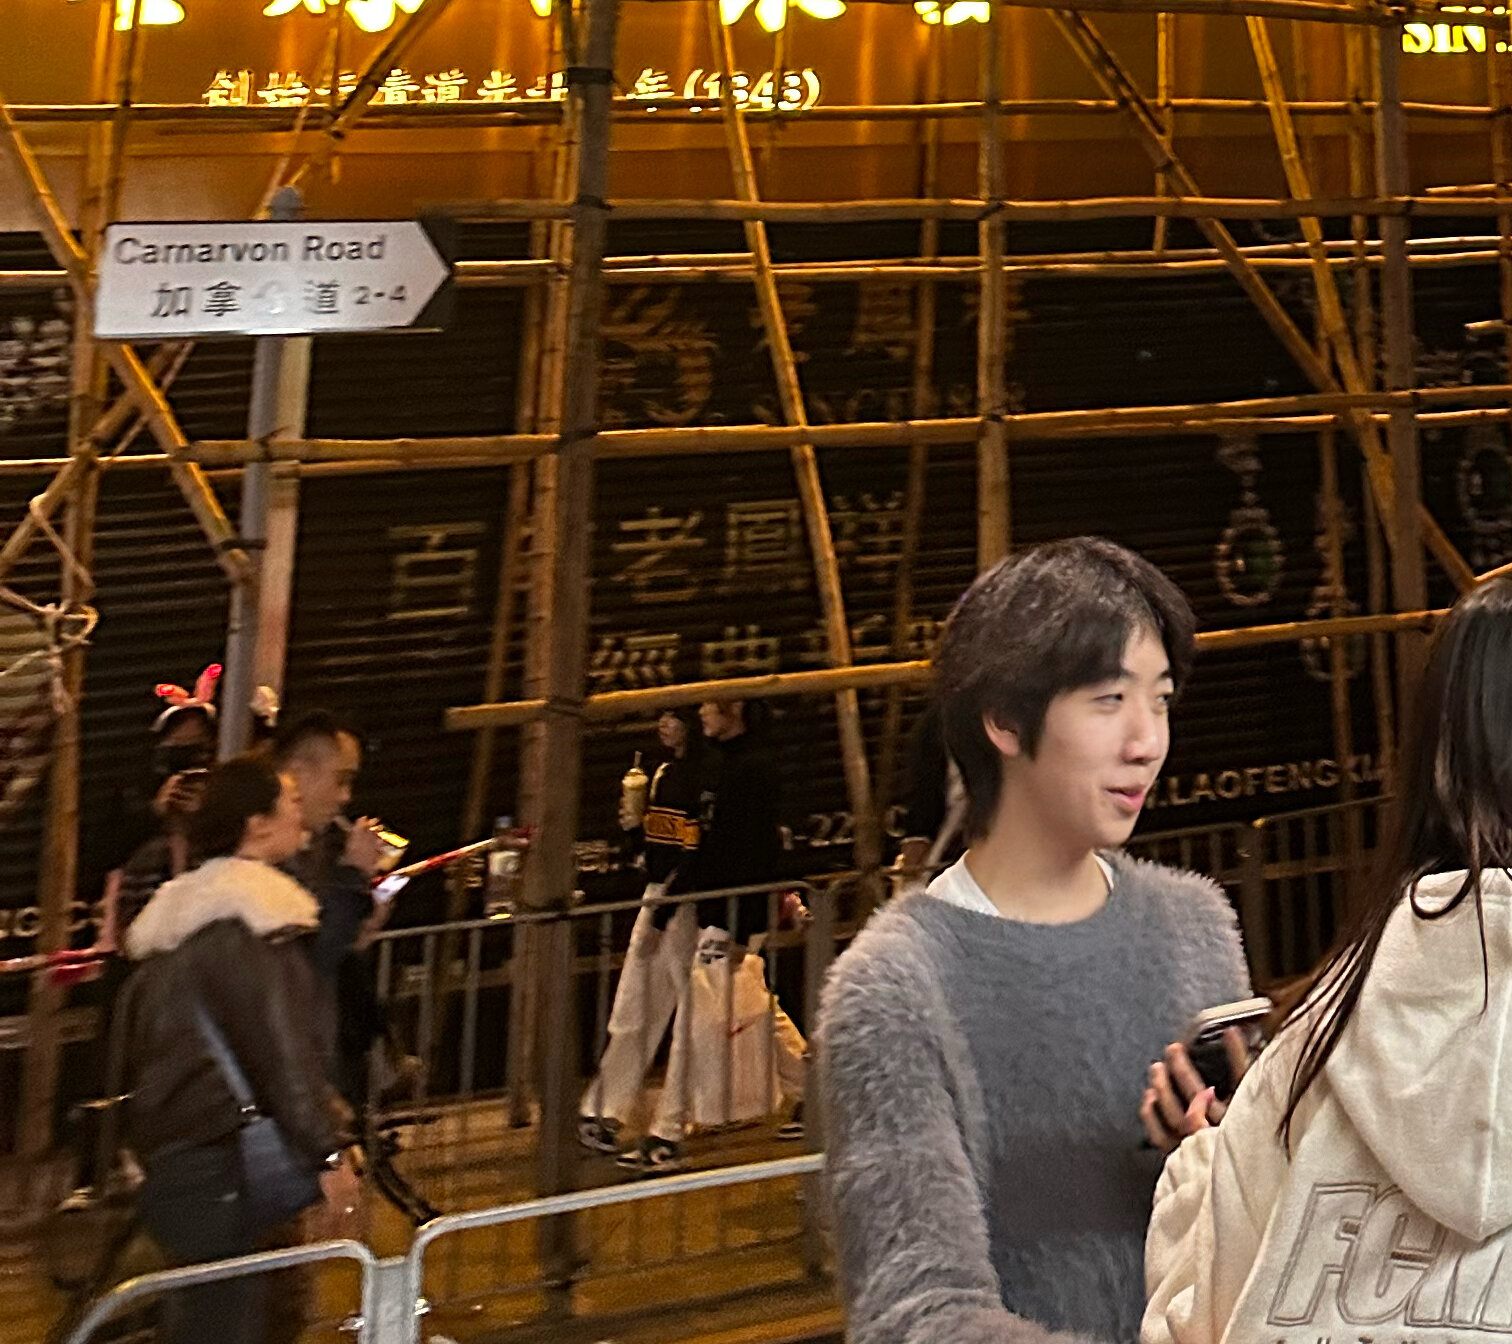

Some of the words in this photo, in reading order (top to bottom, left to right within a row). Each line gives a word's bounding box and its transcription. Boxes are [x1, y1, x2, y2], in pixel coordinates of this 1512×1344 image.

[113, 236, 289, 265] Carnarvon
[302, 234, 387, 261] Road
[152, 279, 340, 317] 加拿道
